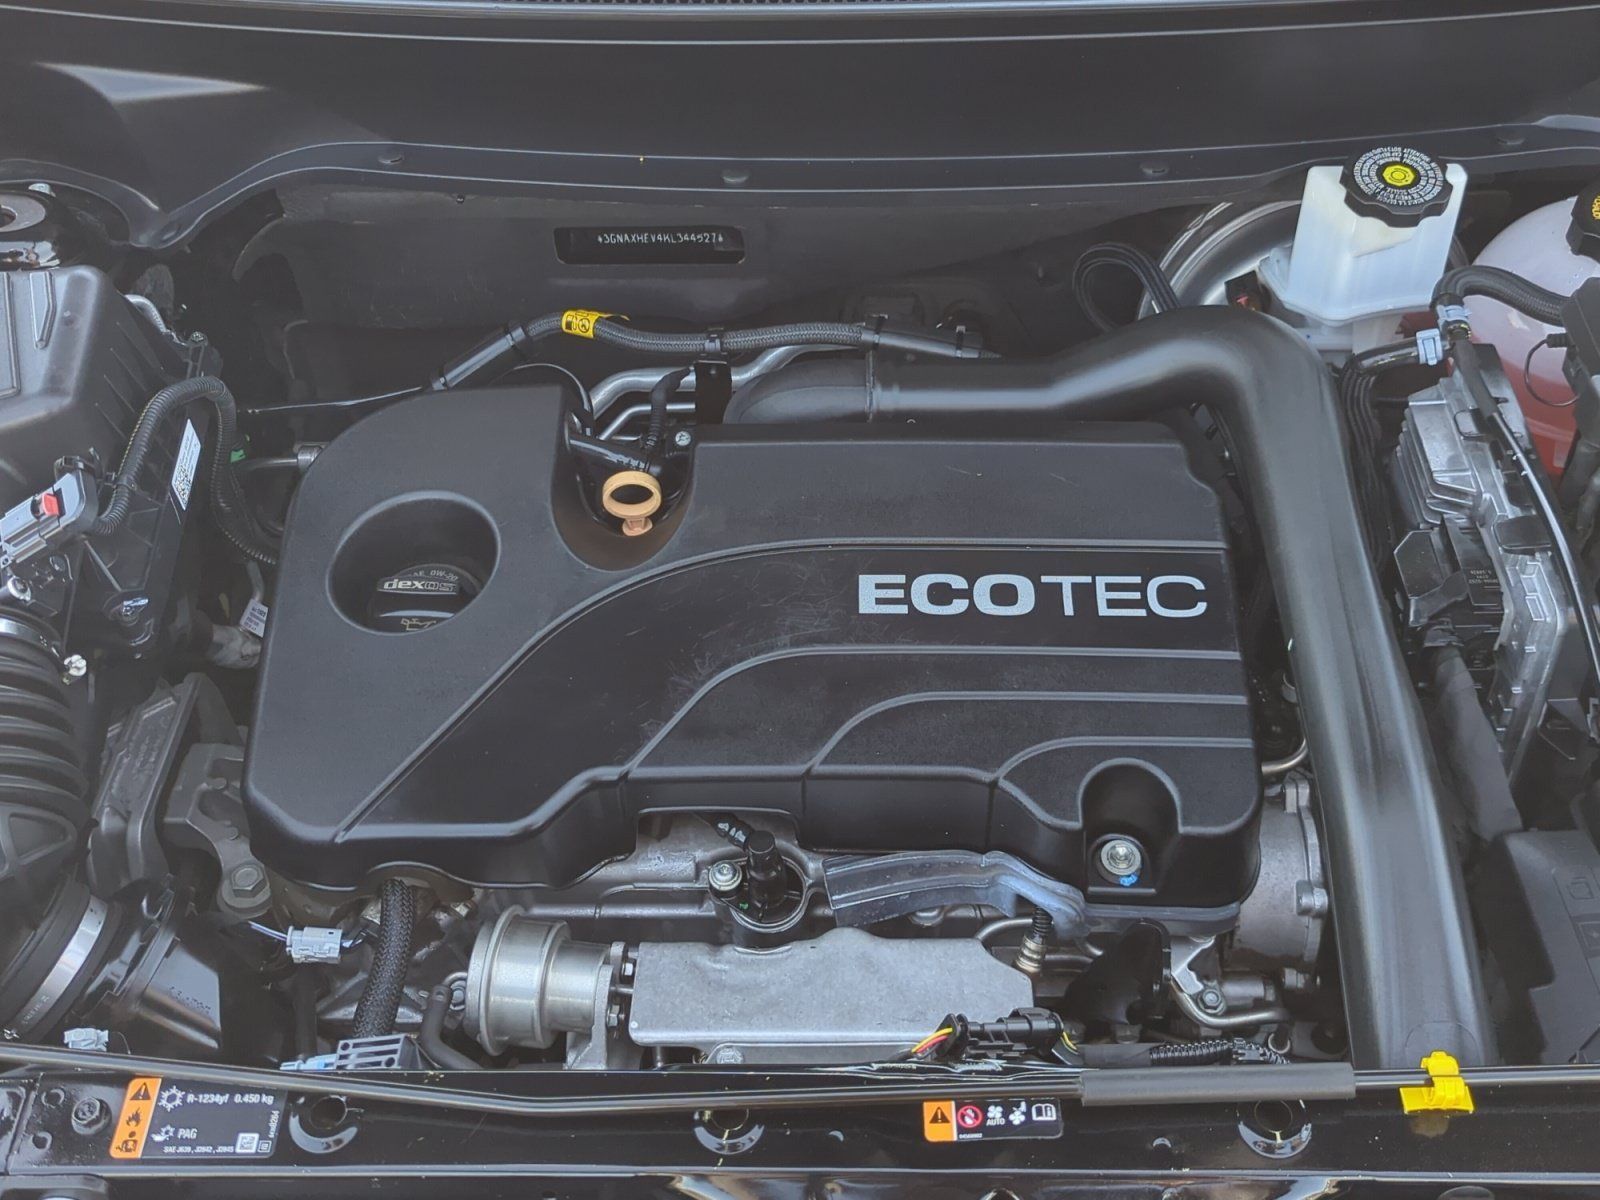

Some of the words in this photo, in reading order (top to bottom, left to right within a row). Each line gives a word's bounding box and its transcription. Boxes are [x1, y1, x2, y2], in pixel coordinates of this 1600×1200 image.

[383, 578, 456, 592] dexos
[858, 572, 1208, 618] ECOTEC
[186, 1093, 229, 1106] R-1234yf
[233, 1093, 261, 1104] 0.450
[261, 1094, 275, 1106] kg
[986, 1118, 1005, 1126] AUTO
[177, 1127, 199, 1140] PAG
[163, 1145, 177, 1153] SAE
